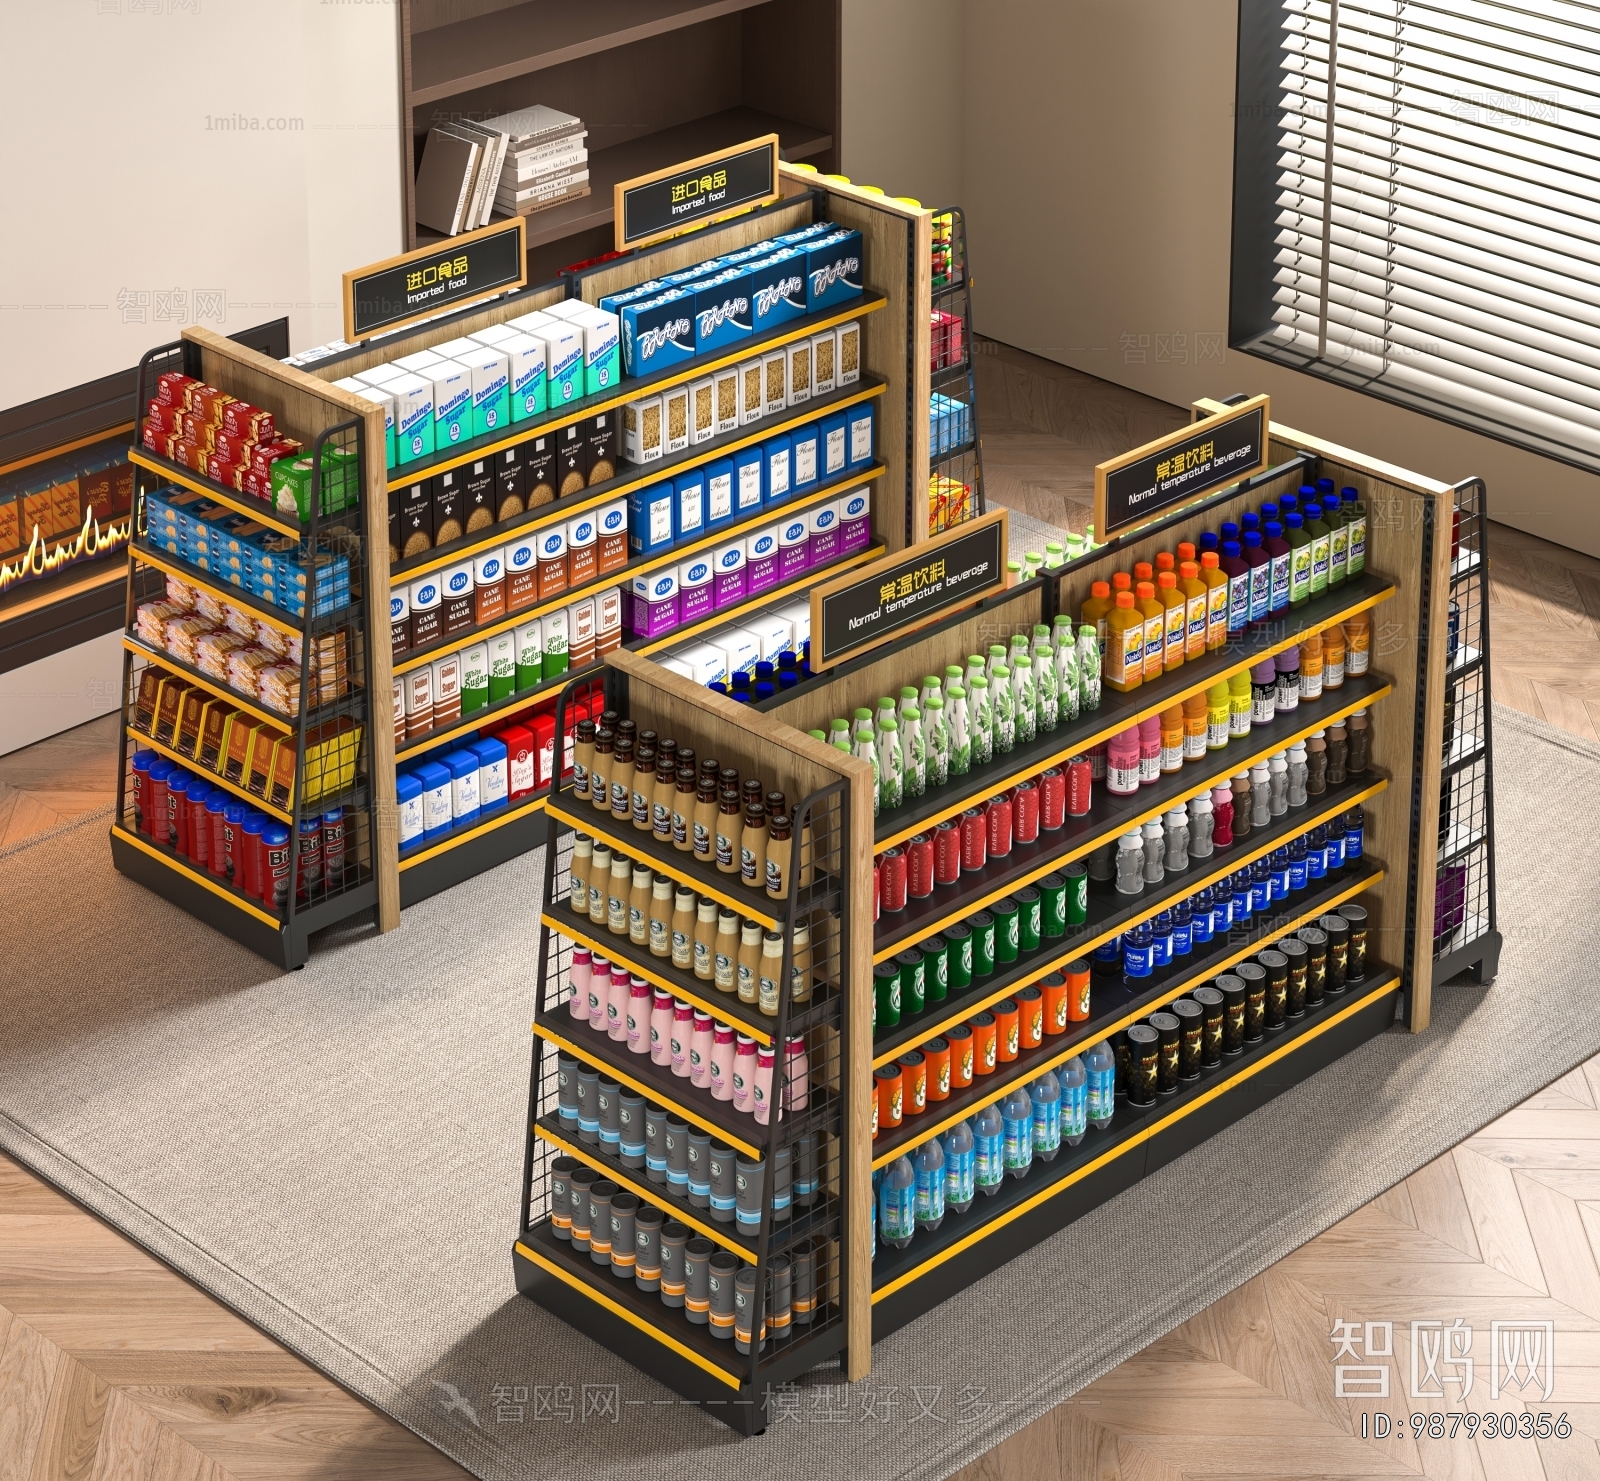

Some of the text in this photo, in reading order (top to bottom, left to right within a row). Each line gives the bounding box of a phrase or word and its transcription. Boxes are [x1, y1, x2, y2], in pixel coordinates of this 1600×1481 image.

[556, 144, 573, 152] NATIONS
[536, 169, 570, 184] Elizabeth Gaskell
[530, 177, 573, 195] BRIANNA WIEST
[672, 170, 726, 202] 进口食品
[538, 187, 567, 201] HOUSE BOOK
[672, 189, 725, 214] Imported food
[407, 256, 468, 291] 进口食品
[408, 275, 466, 304] Imported food
[589, 334, 617, 361] Domingo
[552, 347, 581, 374] Domingo
[595, 351, 614, 371] Sugar
[515, 361, 544, 388] Domingo
[559, 364, 578, 384] Sugar
[475, 375, 507, 402] Domingo
[521, 378, 541, 398] Sugar
[438, 388, 470, 416] Domingo
[482, 392, 502, 412] Sugar
[400, 401, 432, 430] Domingo
[445, 406, 466, 425] Sugar
[408, 418, 428, 439] Sugar
[591, 430, 612, 443] Brown Sugar
[530, 454, 552, 466] Brown Sugar
[1156, 441, 1213, 482] 常温饮料
[275, 472, 298, 488] CUPCAKES
[1129, 445, 1251, 505] Normal temperature beverage
[468, 477, 491, 490] Brown Sugar
[405, 501, 428, 513] Brown Sugar
[849, 500, 862, 512] E&H
[607, 514, 620, 526] E&H
[577, 526, 590, 539] E&H
[848, 521, 863, 533] CANE
[846, 528, 865, 540] SUGAR
[547, 538, 560, 551] E&H
[606, 538, 621, 549] CANE
[757, 538, 770, 551] E&H
[515, 550, 529, 564] E&H
[577, 549, 591, 561] CANE
[604, 545, 623, 557] SUGAR
[575, 557, 593, 569] SUGAR
[724, 552, 738, 565] E&H
[484, 562, 497, 575] E&H
[546, 562, 561, 573] CANE
[755, 560, 772, 571] CANE
[544, 569, 563, 582] SUGAR
[723, 574, 739, 586] CANE
[753, 567, 773, 580] SUGAR
[452, 576, 465, 589] E&H
[514, 575, 530, 586] CANE
[657, 580, 671, 593] E&H
[880, 559, 945, 604] 常温饮料
[484, 587, 499, 599] CANE
[513, 582, 532, 595] SUGAR
[721, 581, 741, 594] SUGAR
[421, 588, 433, 601] E&H
[482, 595, 501, 607] SUGAR
[849, 562, 988, 630] Normal temperature beverage
[451, 600, 467, 613] CANE
[656, 602, 672, 614] CANE
[419, 613, 435, 625] CANE
[449, 609, 469, 621] SUGAR
[654, 610, 674, 623] SUGAR
[418, 621, 437, 634] SUGAR
[579, 623, 591, 635] Sugar
[547, 639, 567, 654] Sugar
[548, 635, 562, 646] White
[522, 646, 536, 657] White
[765, 639, 791, 662] Domingo
[493, 658, 508, 669] White
[522, 650, 541, 666] Sugar
[465, 669, 481, 680] White
[493, 662, 514, 678] Sugar
[442, 682, 455, 693] Sugar
[464, 674, 487, 689] Sugar
[415, 693, 428, 705] Sugar
[1126, 952, 1145, 963] Purely
